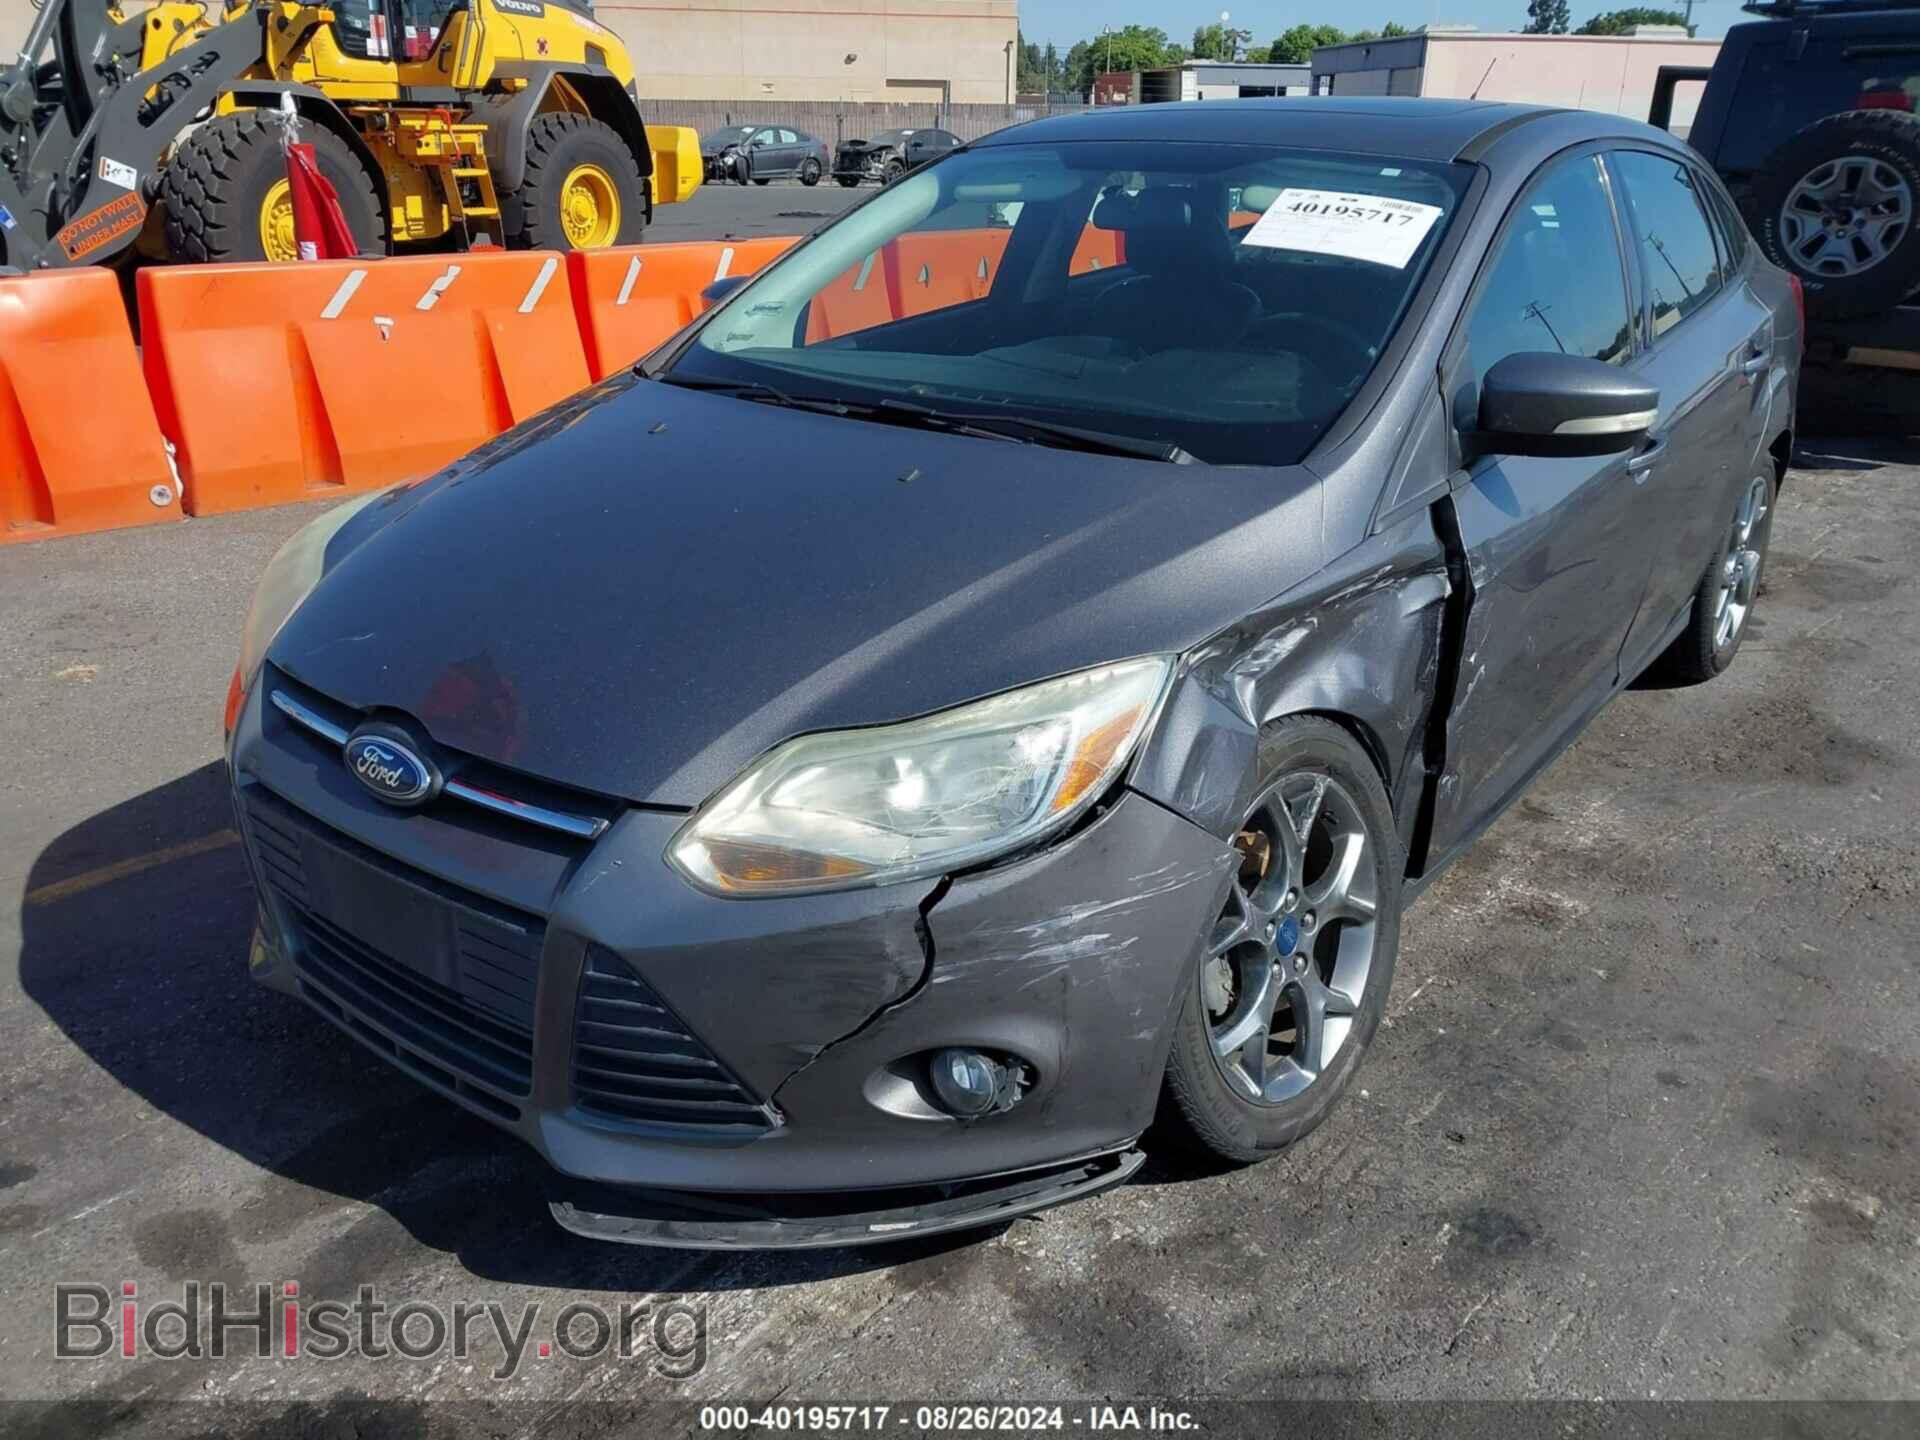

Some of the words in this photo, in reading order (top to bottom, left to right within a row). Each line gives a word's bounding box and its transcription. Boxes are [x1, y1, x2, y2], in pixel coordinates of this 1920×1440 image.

[496, 0, 541, 13] VOLVO
[1287, 201, 1414, 226] 40195717
[356, 745, 403, 787] Ford
